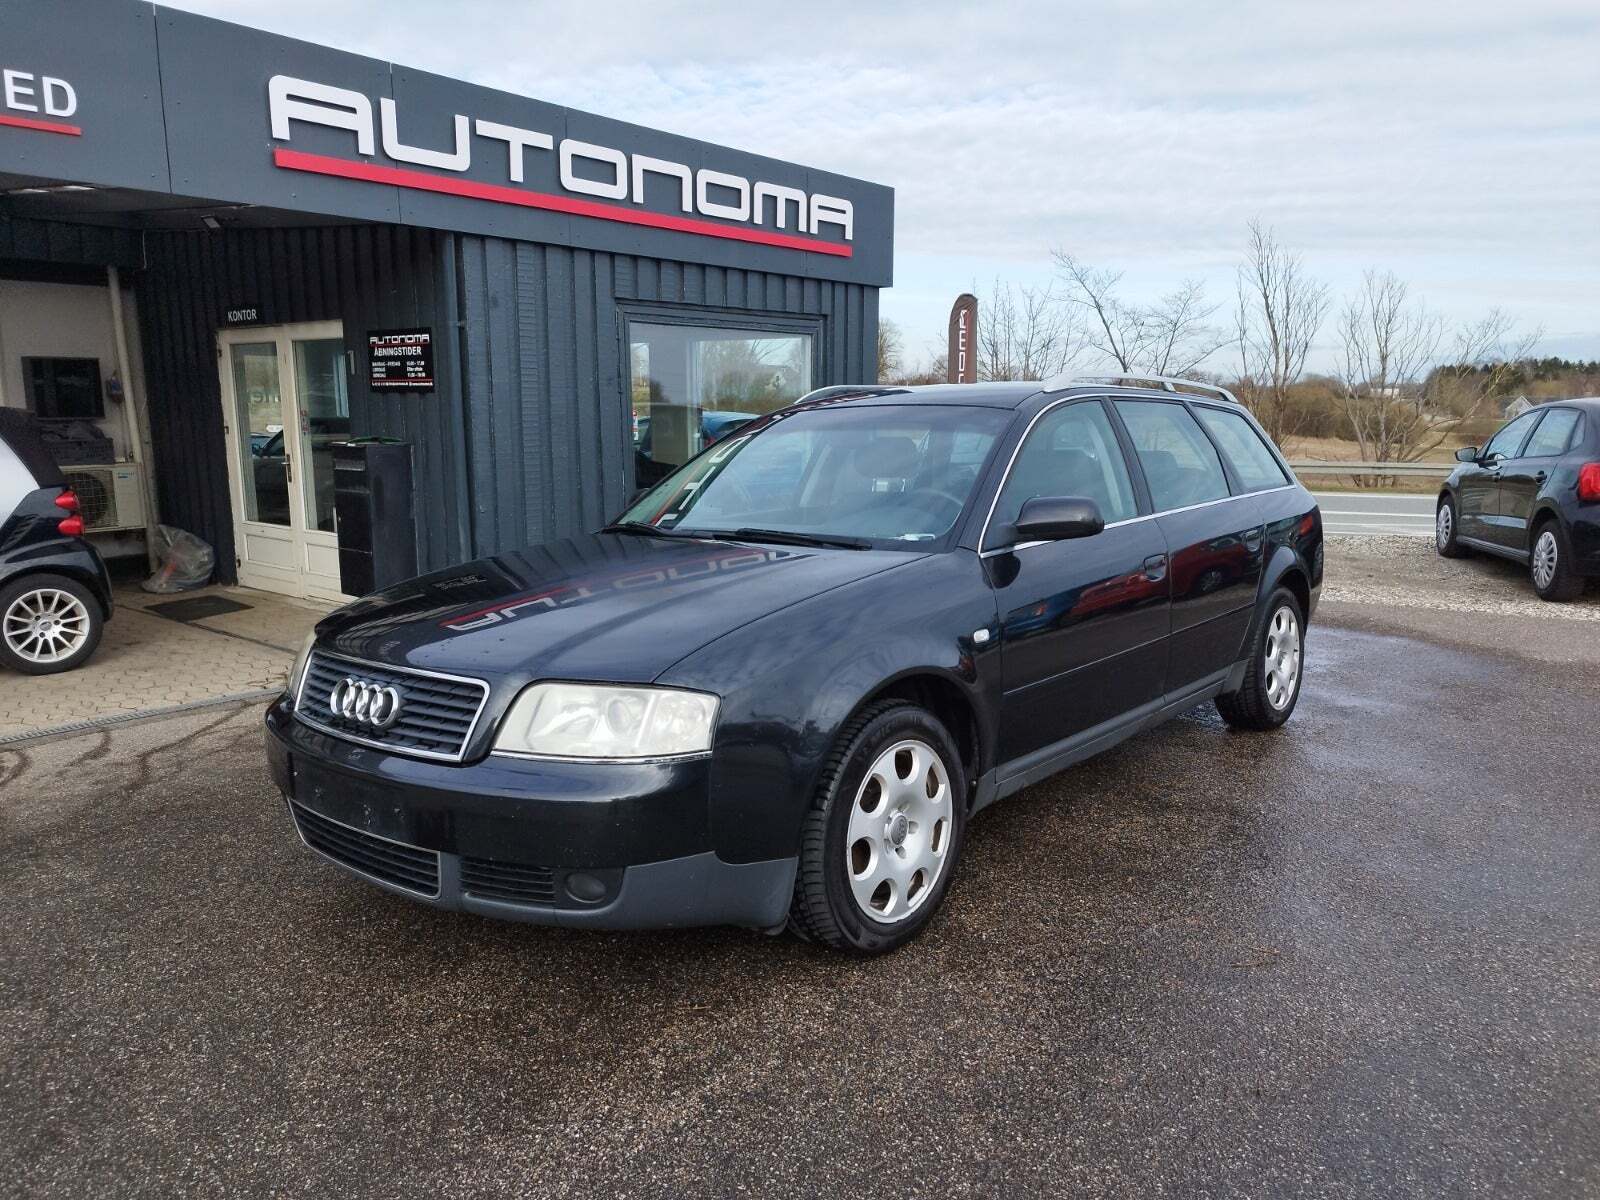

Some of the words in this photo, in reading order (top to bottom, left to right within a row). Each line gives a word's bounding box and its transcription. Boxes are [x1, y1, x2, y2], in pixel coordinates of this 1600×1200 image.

[3, 68, 77, 117] ED
[267, 74, 854, 242] AUTONOMA
[227, 308, 257, 322] KONTOR
[369, 333, 430, 345] AUTONOMA
[373, 346, 422, 357] ÅBNINGSTIDER
